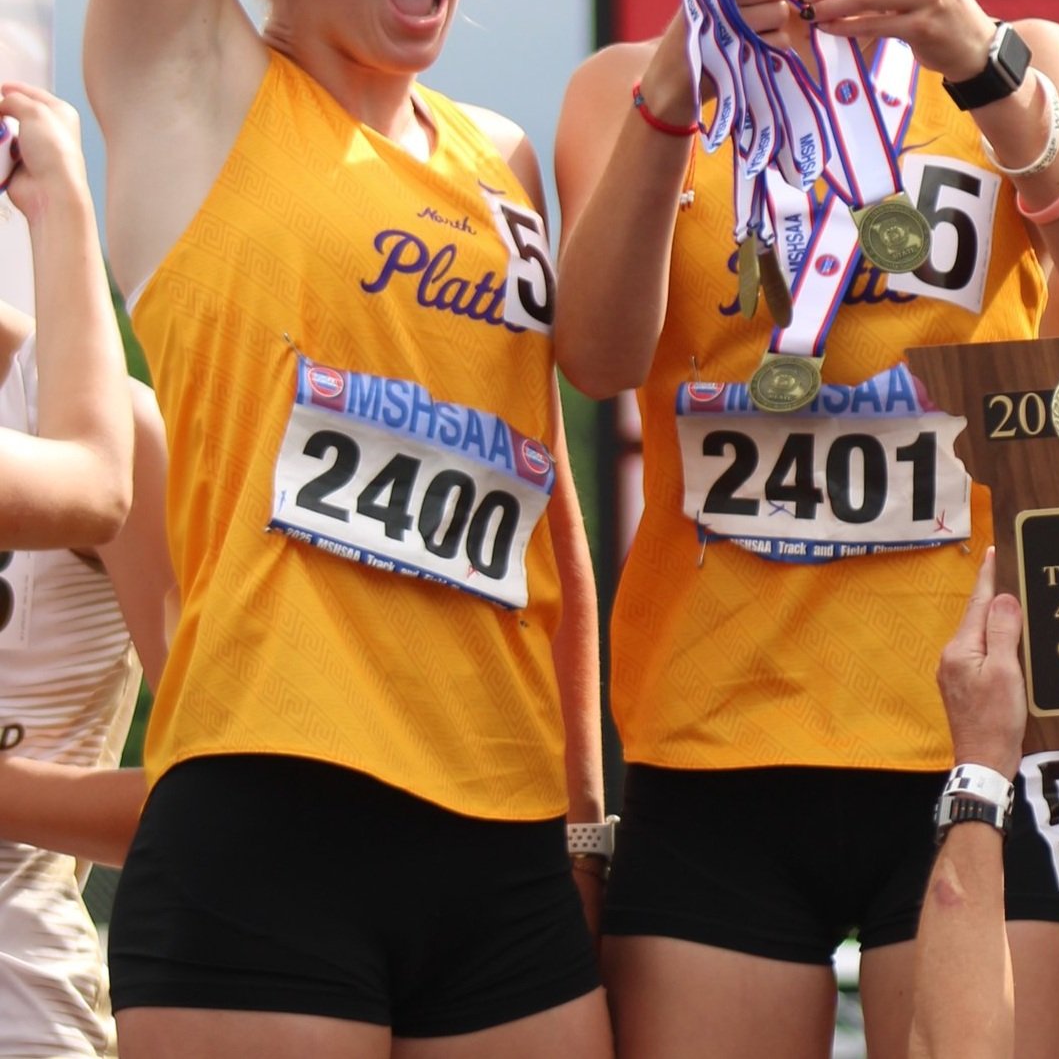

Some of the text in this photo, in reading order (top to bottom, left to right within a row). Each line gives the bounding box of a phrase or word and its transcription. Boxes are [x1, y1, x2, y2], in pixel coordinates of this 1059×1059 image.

[416, 206, 478, 236] North
[499, 203, 557, 327] 5
[913, 164, 982, 291] 5
[360, 229, 529, 334] Platt
[345, 370, 514, 471] MSHSAA
[726, 361, 917, 415] MSAA
[989, 392, 1046, 439] 20
[295, 428, 522, 581] 2400
[702, 429, 938, 525] 2401
[366, 553, 397, 573] Track
[778, 540, 807, 556] Track
[813, 541, 834, 558] and
[840, 544, 867, 557] Field
